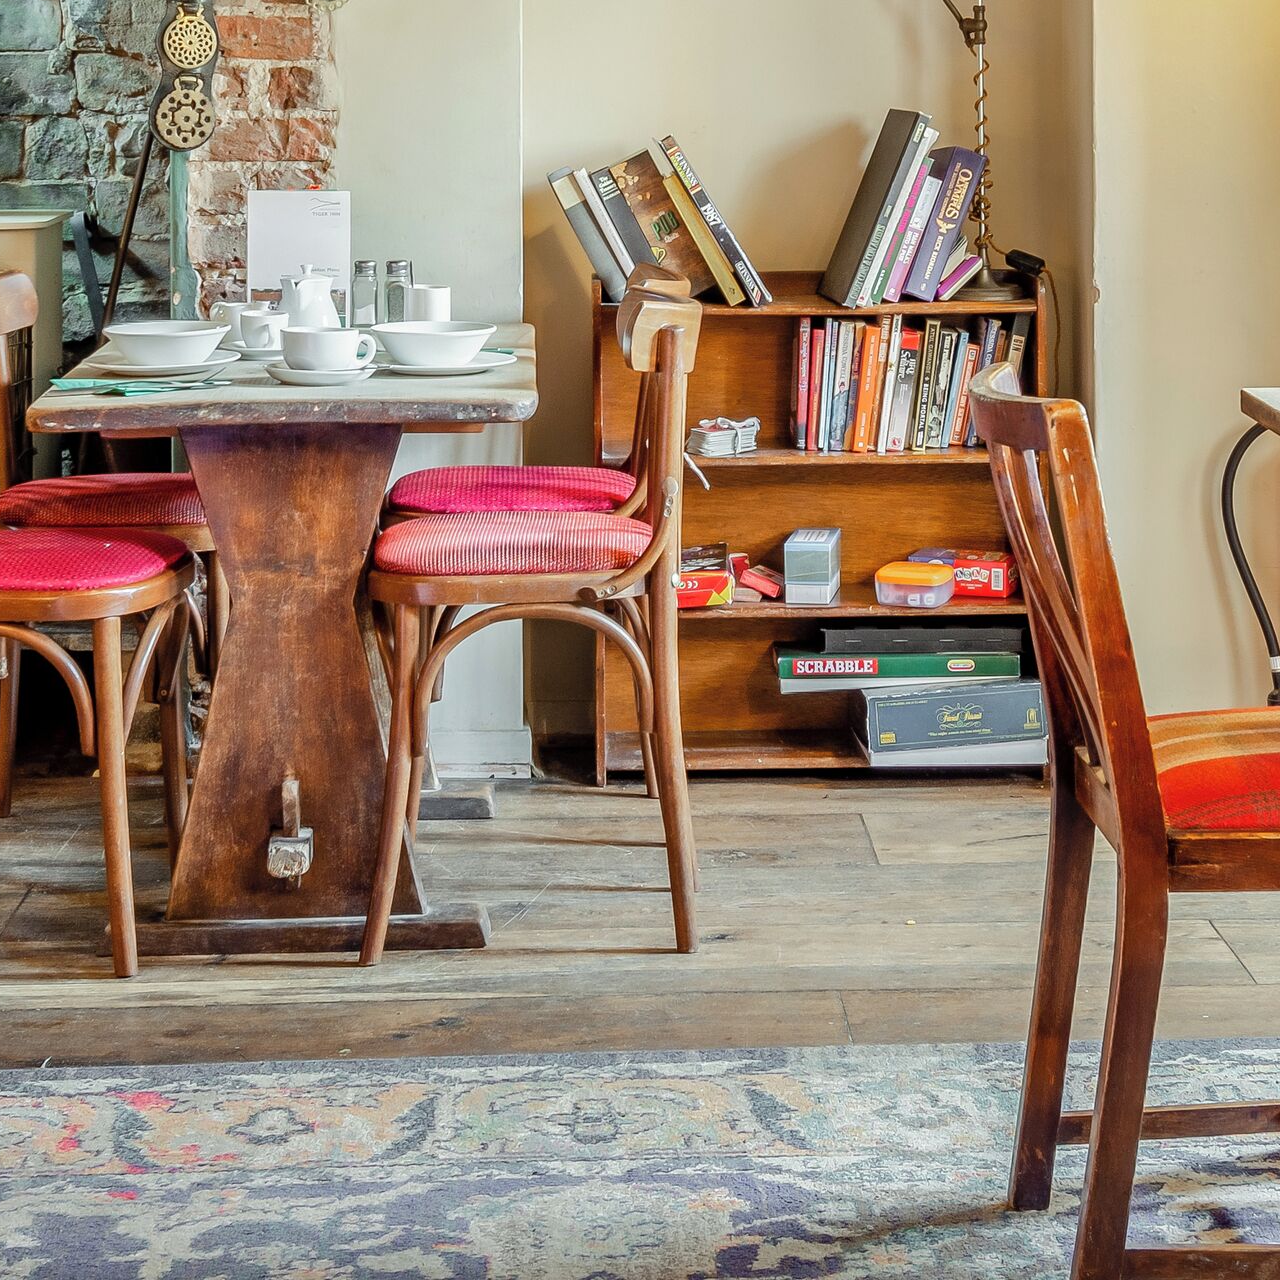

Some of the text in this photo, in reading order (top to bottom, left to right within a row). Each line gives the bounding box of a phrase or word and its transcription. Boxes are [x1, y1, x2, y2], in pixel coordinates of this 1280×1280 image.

[675, 152, 698, 186] GUINNESS
[946, 169, 972, 219] OLYMPUS
[651, 210, 678, 240] PUB
[700, 203, 722, 226] 1987
[910, 232, 920, 245] MAN
[902, 245, 915, 265] WALKS
[925, 250, 939, 280] RIORDAN
[1012, 338, 1024, 352] GIN
[926, 344, 934, 373] GAWANDE
[918, 405, 927, 429] MORTAL
[796, 660, 873, 674] SCRABBLE
